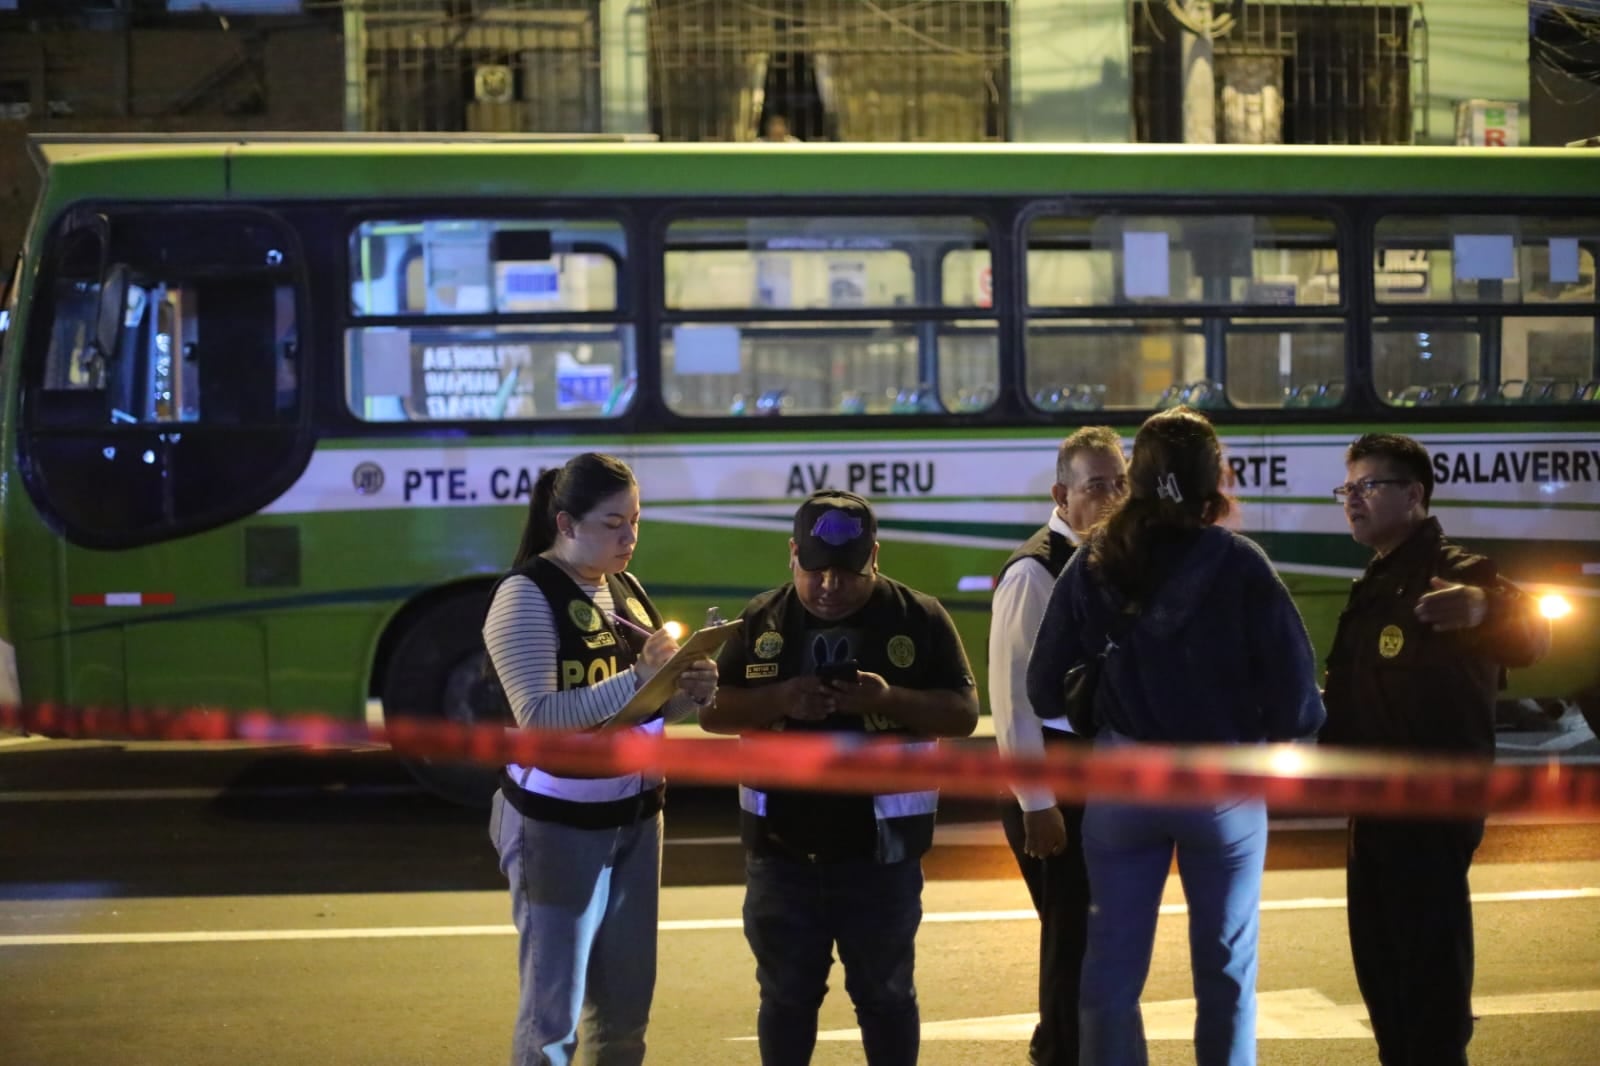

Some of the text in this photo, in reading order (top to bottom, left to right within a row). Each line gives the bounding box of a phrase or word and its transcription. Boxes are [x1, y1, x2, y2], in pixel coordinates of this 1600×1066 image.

[404, 469, 478, 501] PTE.
[490, 467, 546, 499] CA
[848, 462, 935, 493] PERU
[1220, 456, 1287, 488] RTE
